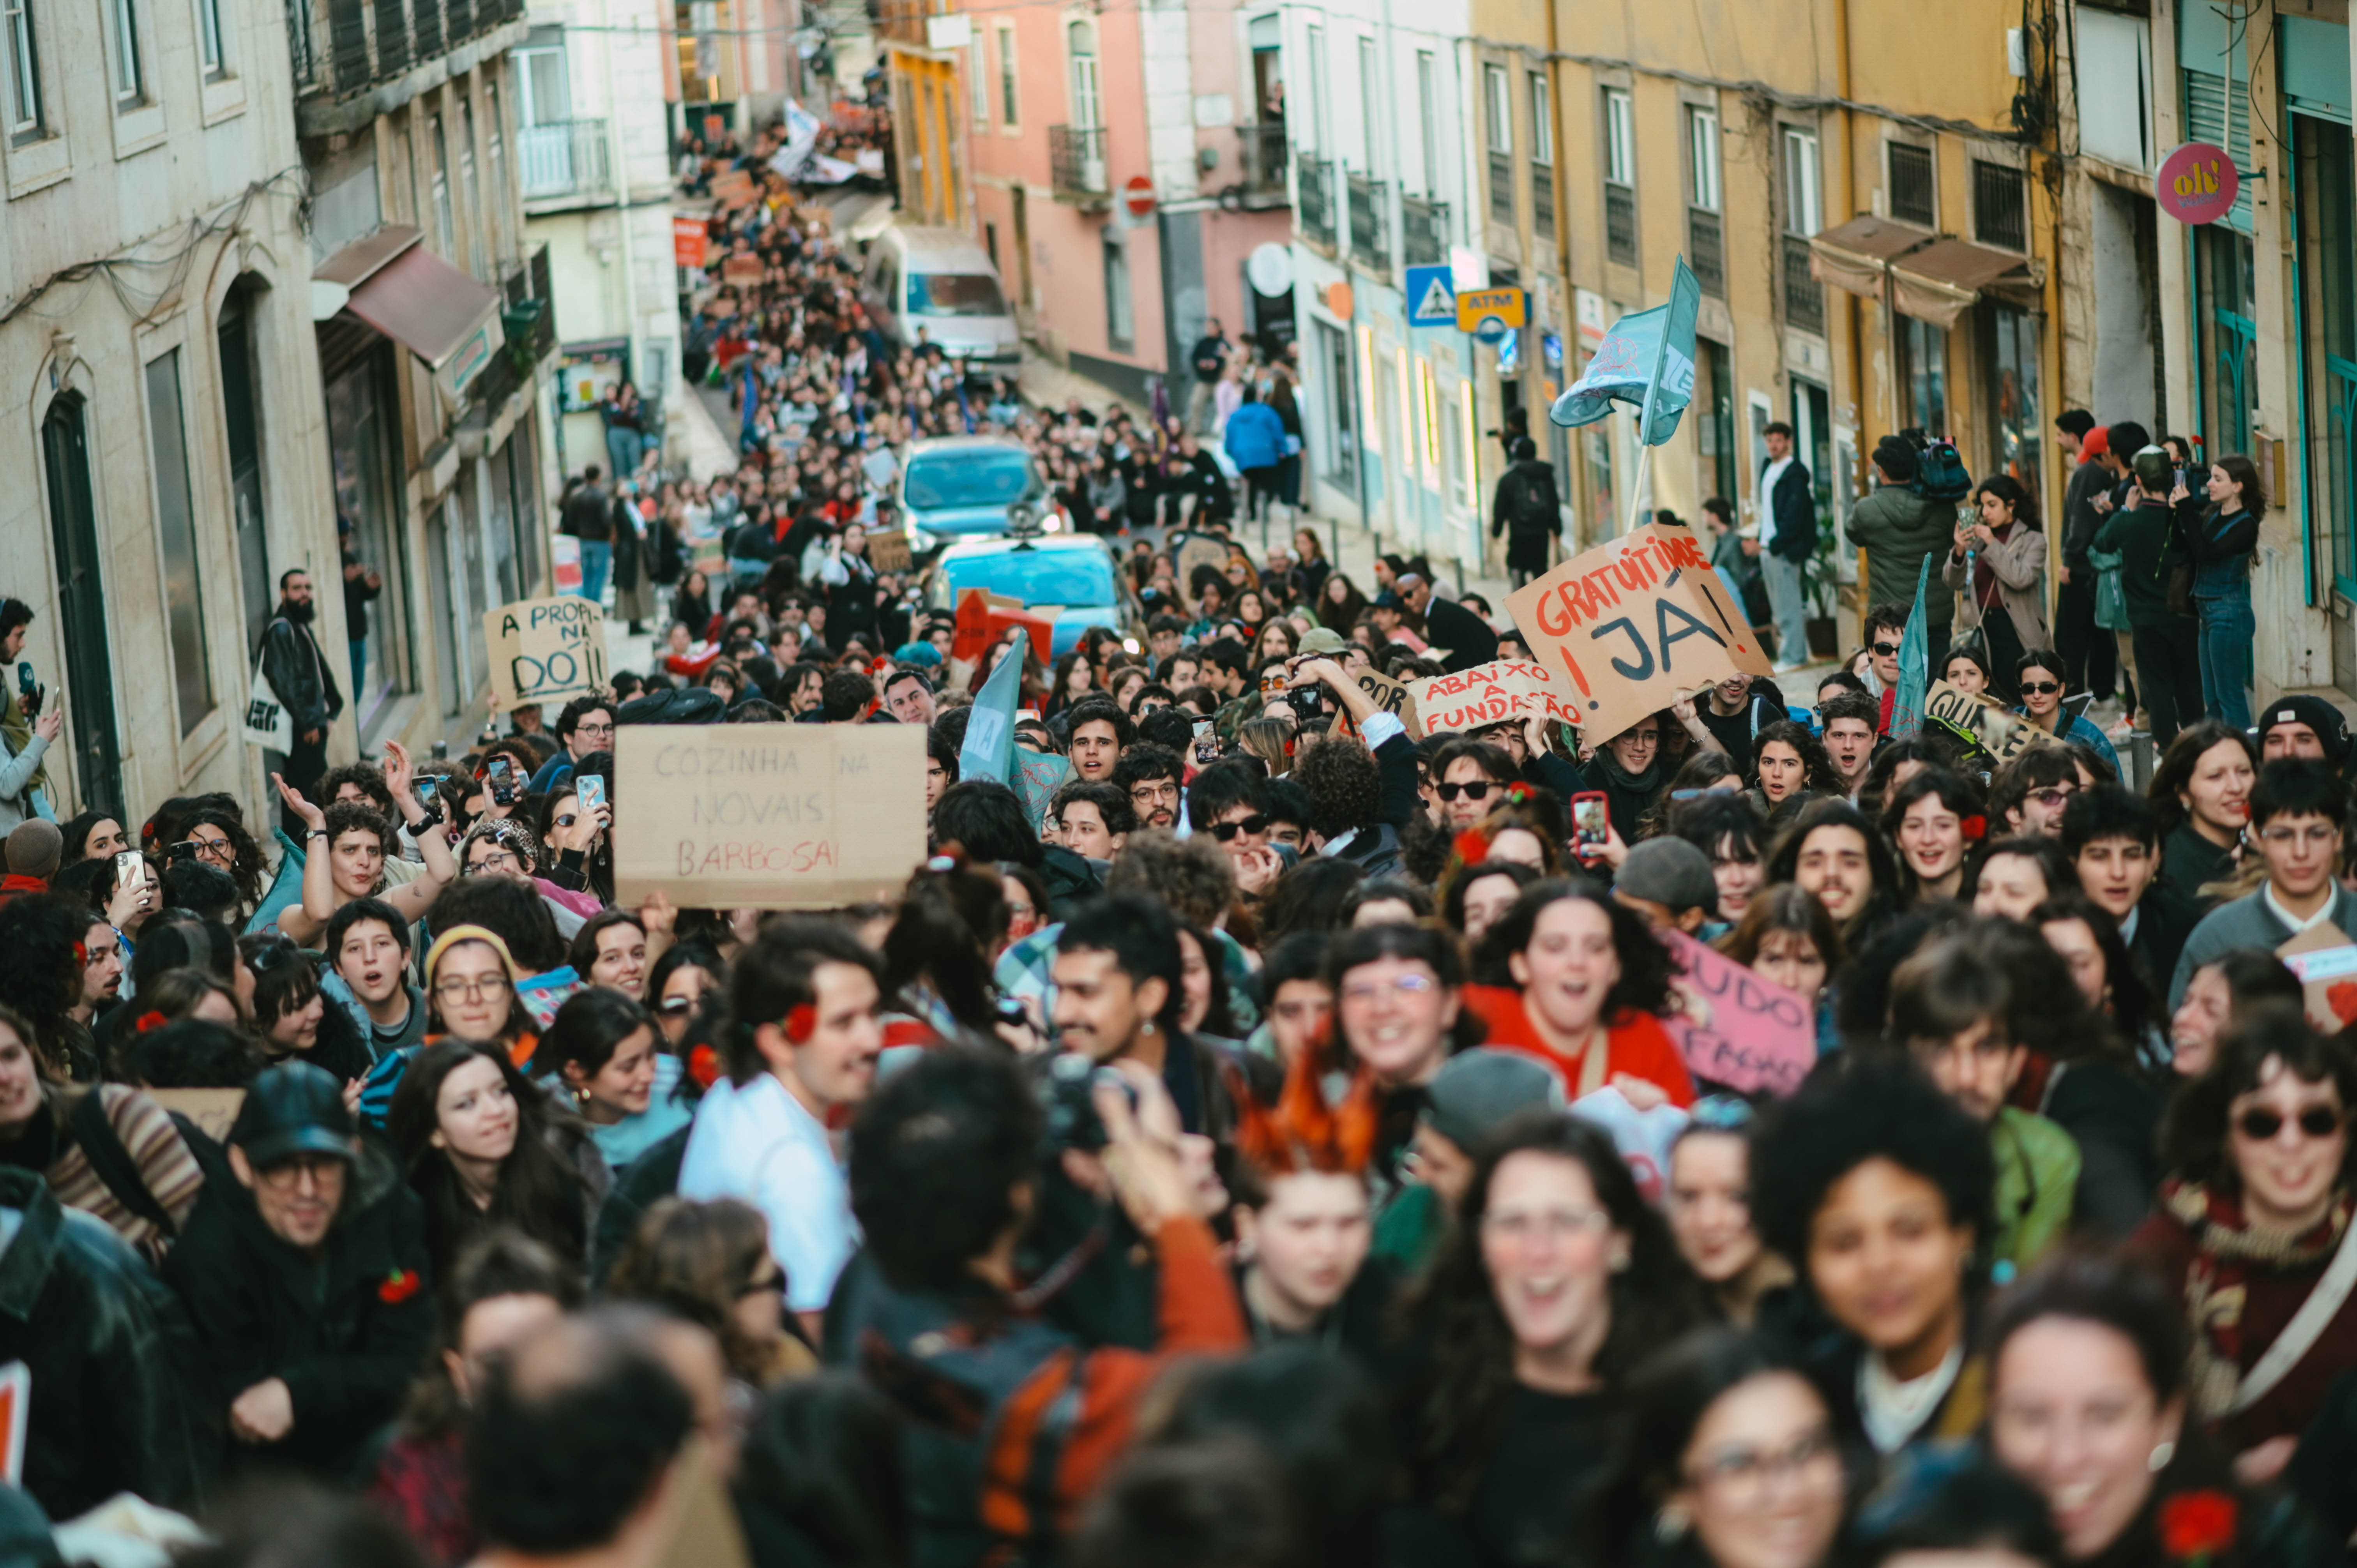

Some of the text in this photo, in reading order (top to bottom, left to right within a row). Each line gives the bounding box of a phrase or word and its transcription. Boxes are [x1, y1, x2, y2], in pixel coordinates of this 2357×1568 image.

[1468, 294, 1513, 309] ATM
[502, 613, 520, 638] A
[560, 623, 592, 641] NA
[1358, 676, 1407, 717] POR
[1484, 684, 1507, 700] A
[1426, 691, 1582, 734] FUNDAÃO
[655, 744, 870, 777] COZINHA NA
[692, 790, 823, 826] NOVAIS
[1693, 952, 1804, 1029] UDO
